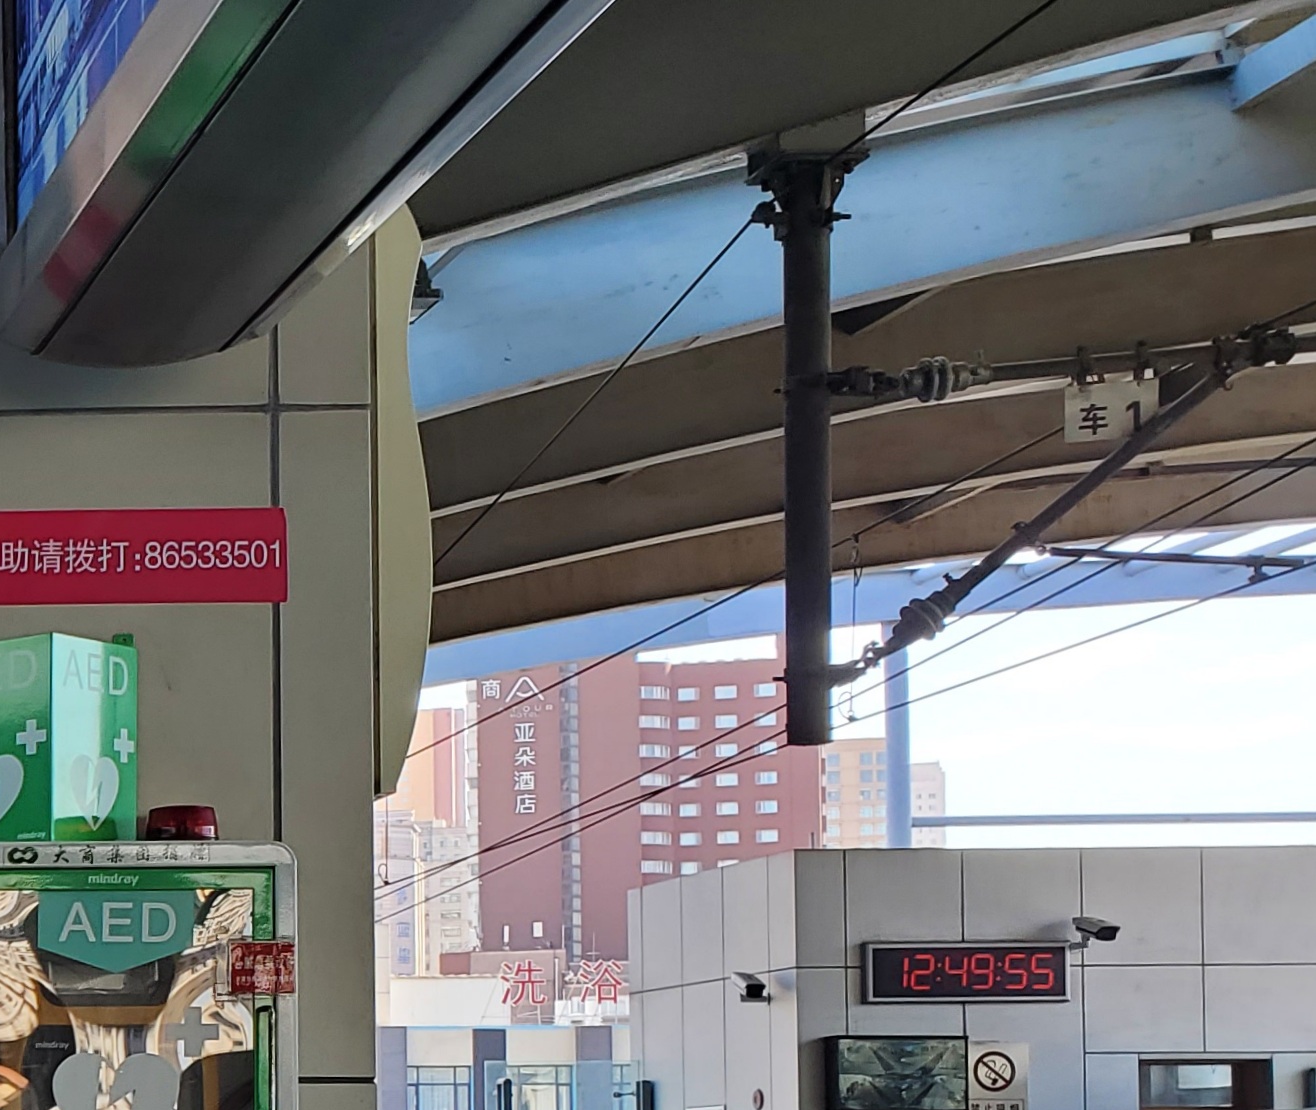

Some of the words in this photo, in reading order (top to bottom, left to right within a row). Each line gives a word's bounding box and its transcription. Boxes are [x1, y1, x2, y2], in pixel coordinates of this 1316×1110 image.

[1078, 403, 1109, 436] 车
[1125, 400, 1142, 431] 1
[62, 649, 129, 696] AED
[481, 679, 501, 700] 商
[513, 722, 537, 814] 亚朵酒店
[88, 873, 139, 887] mindray
[58, 901, 177, 943] AED
[500, 958, 625, 1006] 洗浴
[902, 953, 1056, 992] 12:49:55
